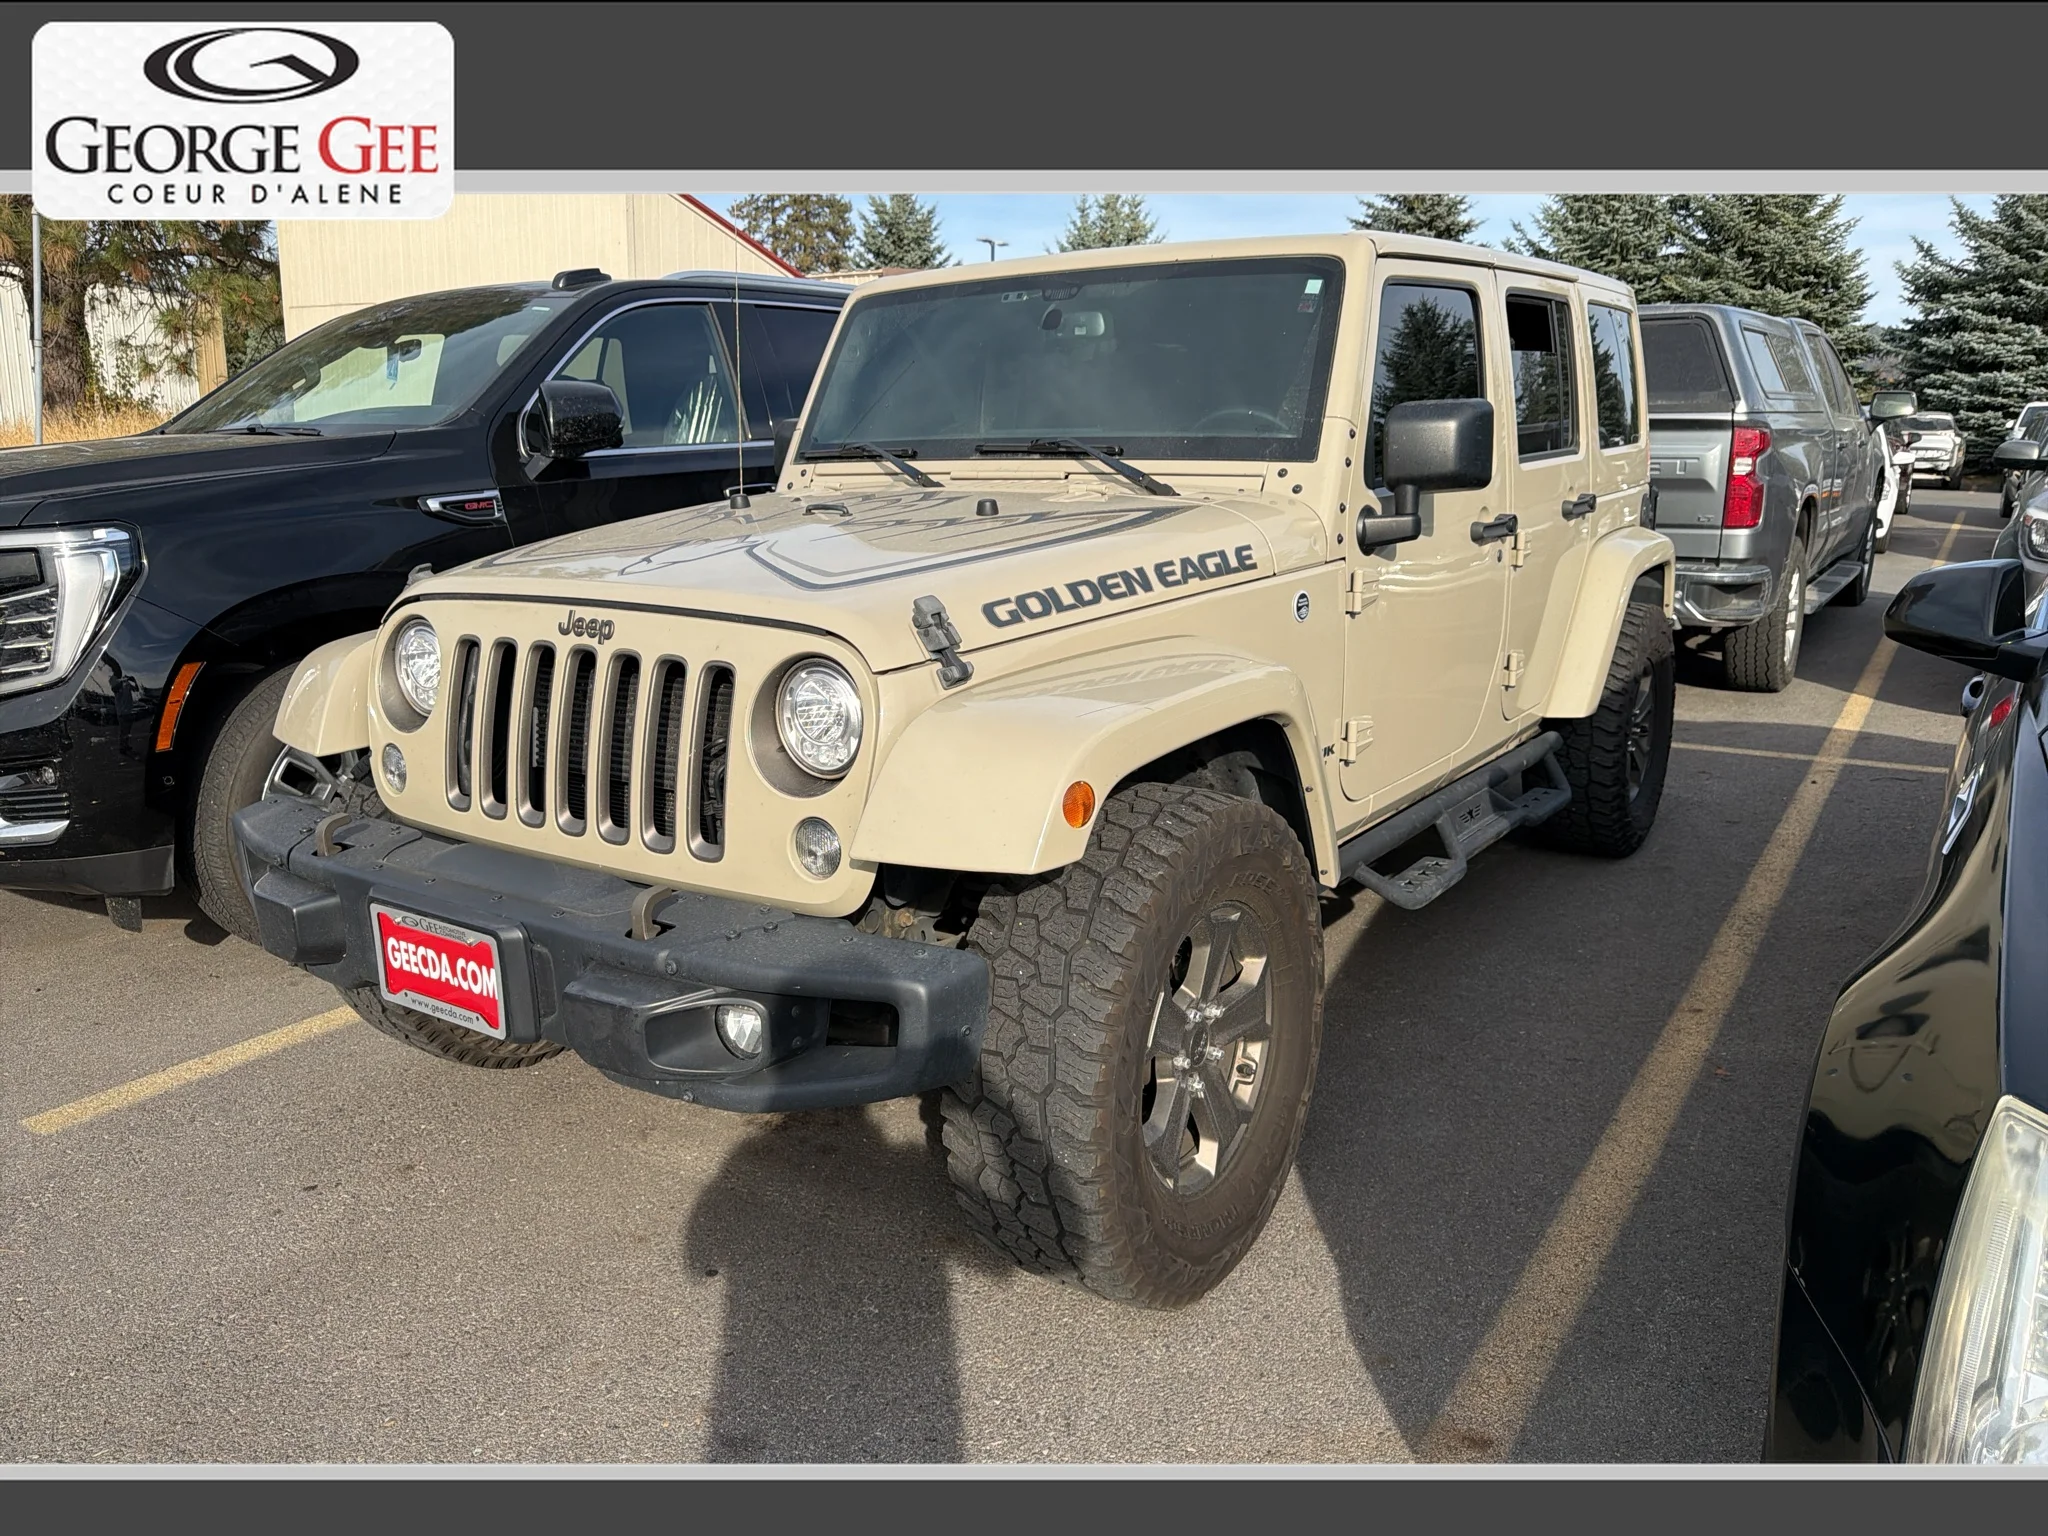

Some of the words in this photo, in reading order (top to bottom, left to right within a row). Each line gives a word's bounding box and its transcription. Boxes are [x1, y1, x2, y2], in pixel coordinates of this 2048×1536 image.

[464, 501, 494, 510] GMC
[981, 565, 1155, 629] GOLDEN
[1153, 544, 1258, 588] EAGLE
[558, 609, 615, 645] Jeep
[387, 937, 498, 1000] GEECDA.COM
[411, 997, 474, 1025] www.geecda.com
